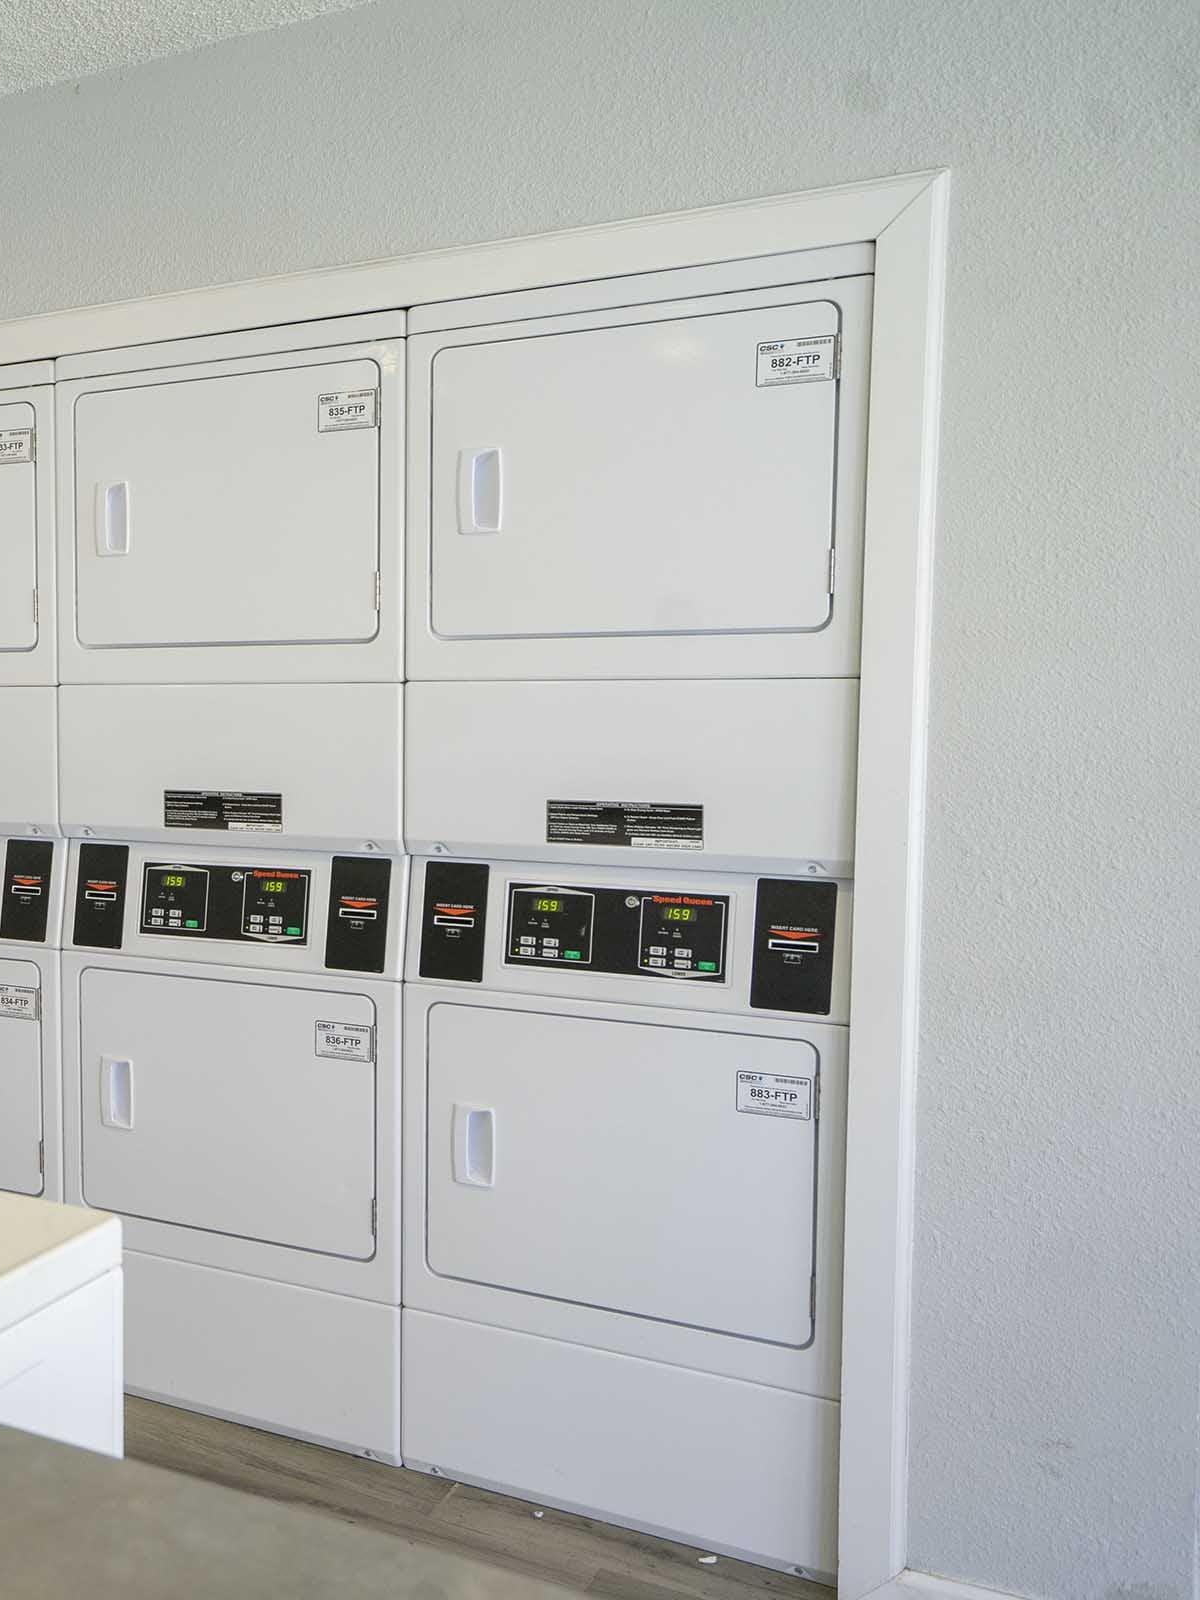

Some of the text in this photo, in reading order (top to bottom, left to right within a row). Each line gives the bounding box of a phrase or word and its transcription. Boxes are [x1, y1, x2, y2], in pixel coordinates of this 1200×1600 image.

[760, 344, 779, 352] CSC
[770, 355, 821, 368] 882-FTP
[328, 405, 365, 417] 835-FTP
[165, 875, 183, 886] 159
[264, 881, 282, 892] 159
[536, 900, 558, 911] 159
[652, 896, 713, 905] Speed Queen
[667, 908, 690, 920] 159
[0, 997, 29, 1007] 834-FTP
[325, 1035, 361, 1046] 836-FTP
[750, 1088, 798, 1102] 883-FTP
